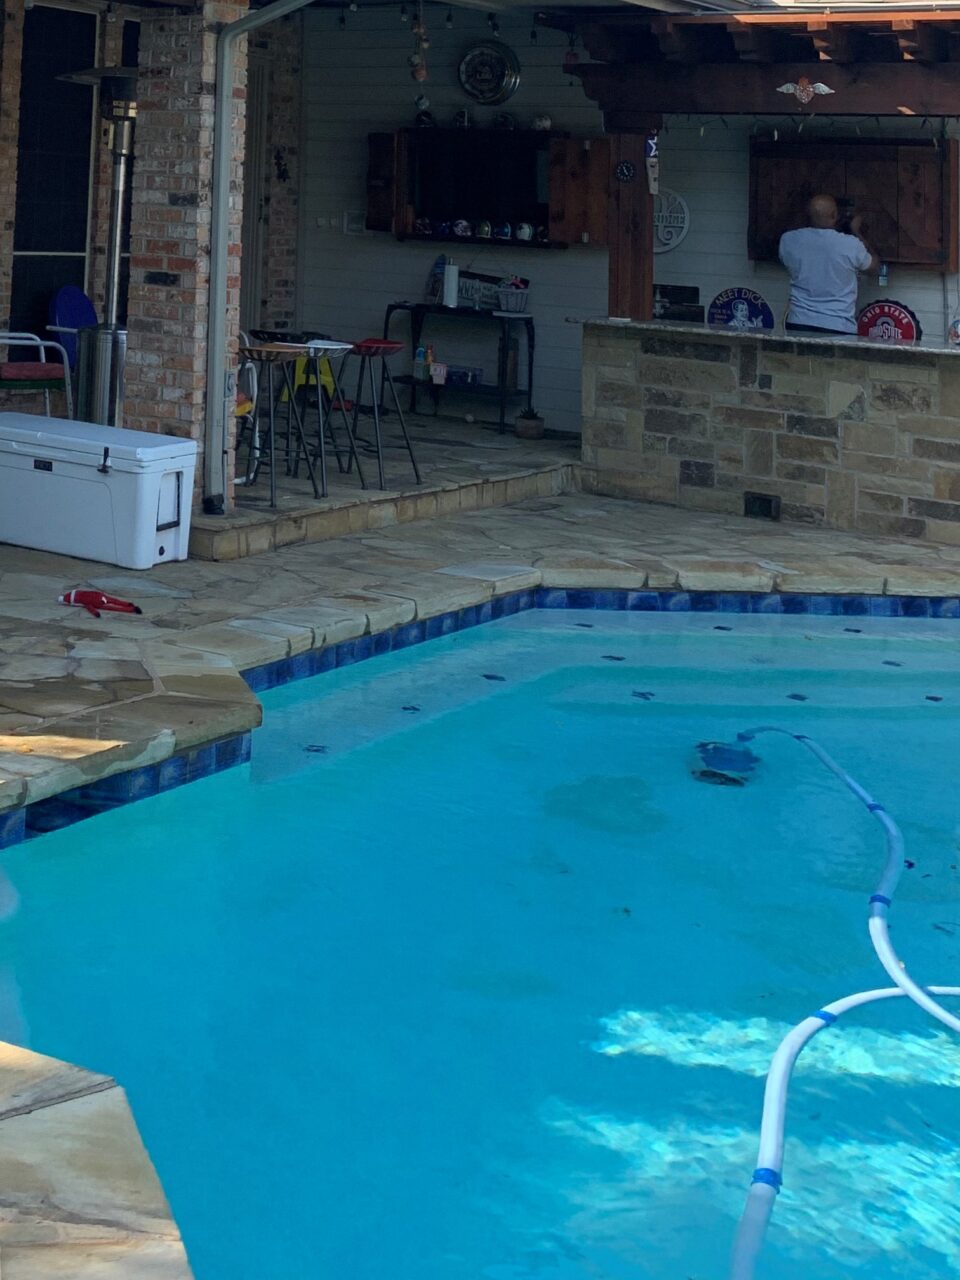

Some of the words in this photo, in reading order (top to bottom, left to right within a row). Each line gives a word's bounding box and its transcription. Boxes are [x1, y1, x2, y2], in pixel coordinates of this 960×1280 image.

[715, 288, 738, 306] MEET
[741, 289, 766, 310] DICK
[862, 307, 880, 323] OHIO
[883, 306, 910, 325] STATE
